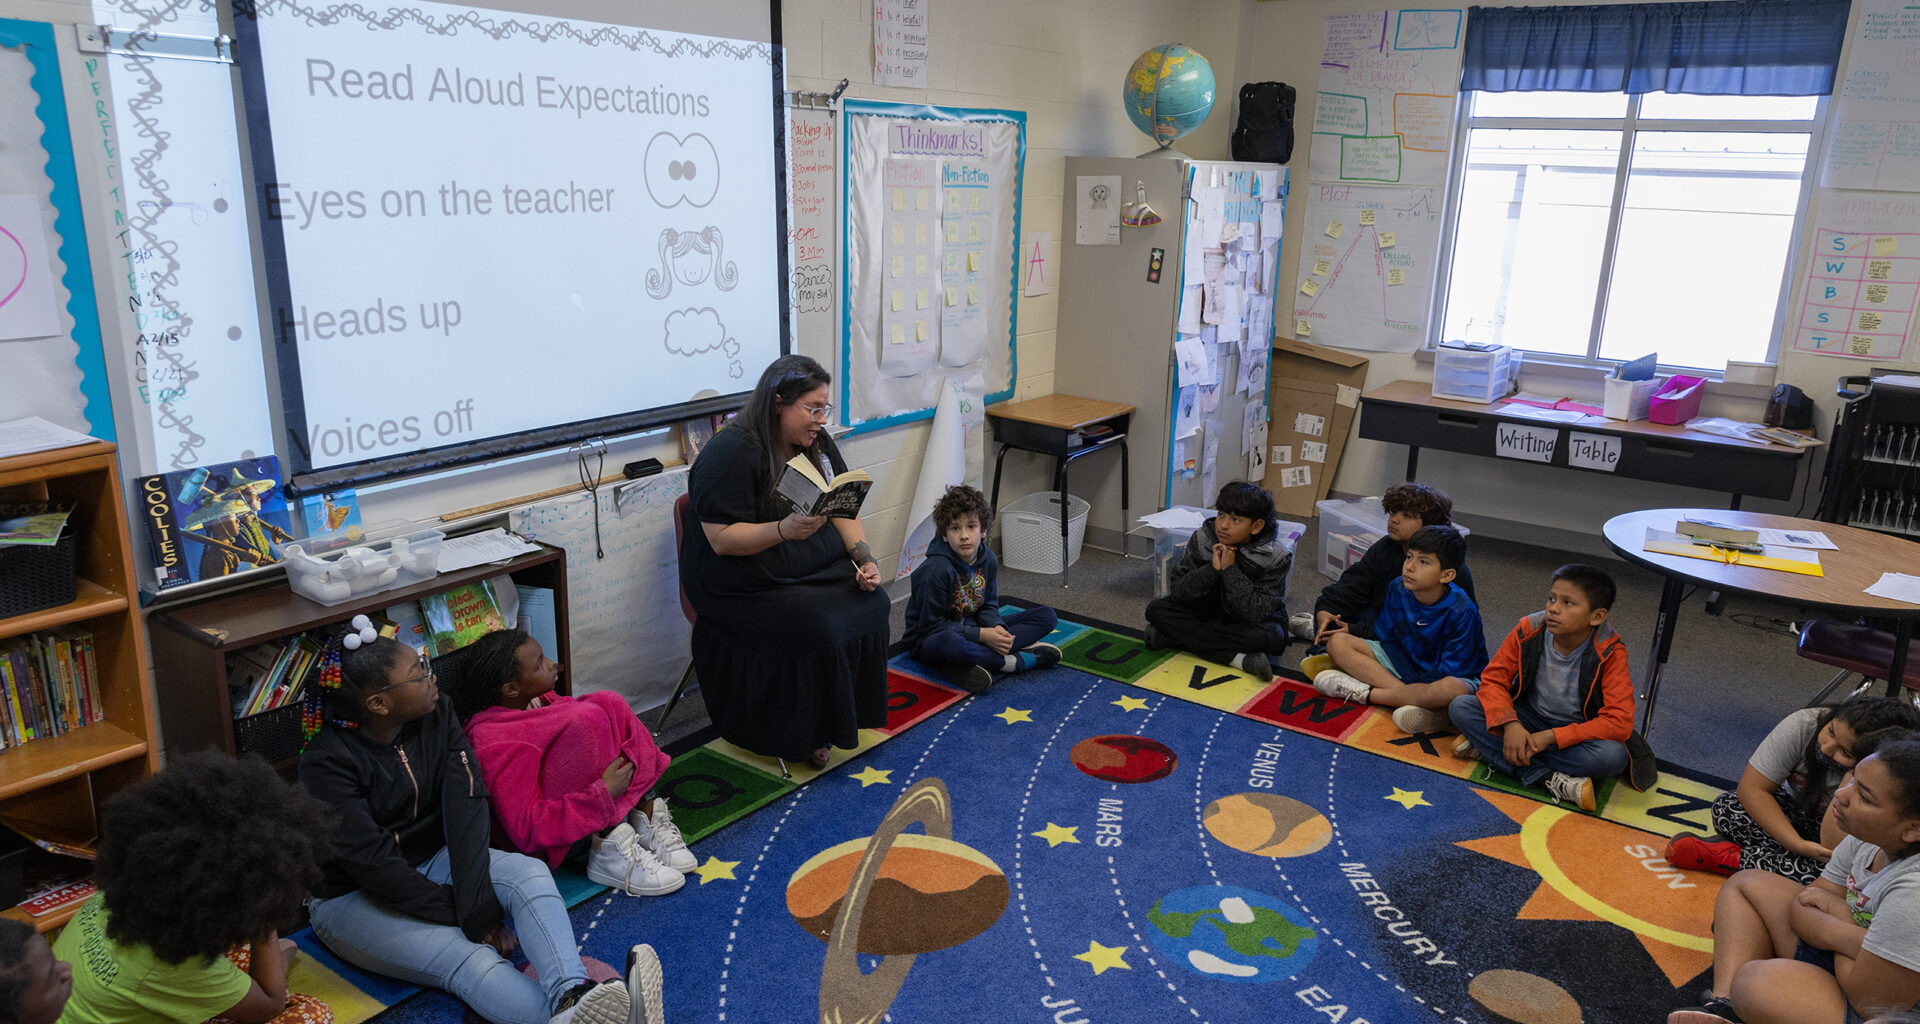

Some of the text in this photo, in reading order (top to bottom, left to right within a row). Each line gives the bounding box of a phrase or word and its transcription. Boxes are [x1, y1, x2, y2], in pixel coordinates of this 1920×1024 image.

[305, 57, 711, 119] Read Aloud Expectations
[896, 125, 984, 153] Thinkmarks!
[943, 165, 990, 184] Non-Fiction
[264, 180, 615, 230] Eyes on the teacher
[1320, 186, 1353, 202] Plot
[1833, 237, 1846, 252] S
[1027, 241, 1045, 287] A
[1825, 261, 1845, 274] W
[796, 271, 827, 290] Dance
[1824, 286, 1837, 300] B
[279, 298, 462, 344] Heads up
[1817, 312, 1830, 324] S
[151, 331, 179, 346] 2/15
[1811, 336, 1828, 350] T
[288, 398, 476, 462] Voices off
[1500, 427, 1618, 463] Writing Table
[144, 476, 178, 568] COOLIES
[447, 589, 475, 610] black
[452, 599, 487, 620] brown
[464, 613, 483, 629] tan
[1084, 641, 1142, 665] U
[1188, 664, 1242, 691] V
[1278, 689, 1357, 724] W
[1385, 730, 1457, 758] X
[1248, 742, 1285, 790] VENUS
[656, 773, 747, 811] Q
[1095, 797, 1124, 849] MARS
[1624, 843, 1698, 890] SUN
[1339, 861, 1458, 969] MERCURY
